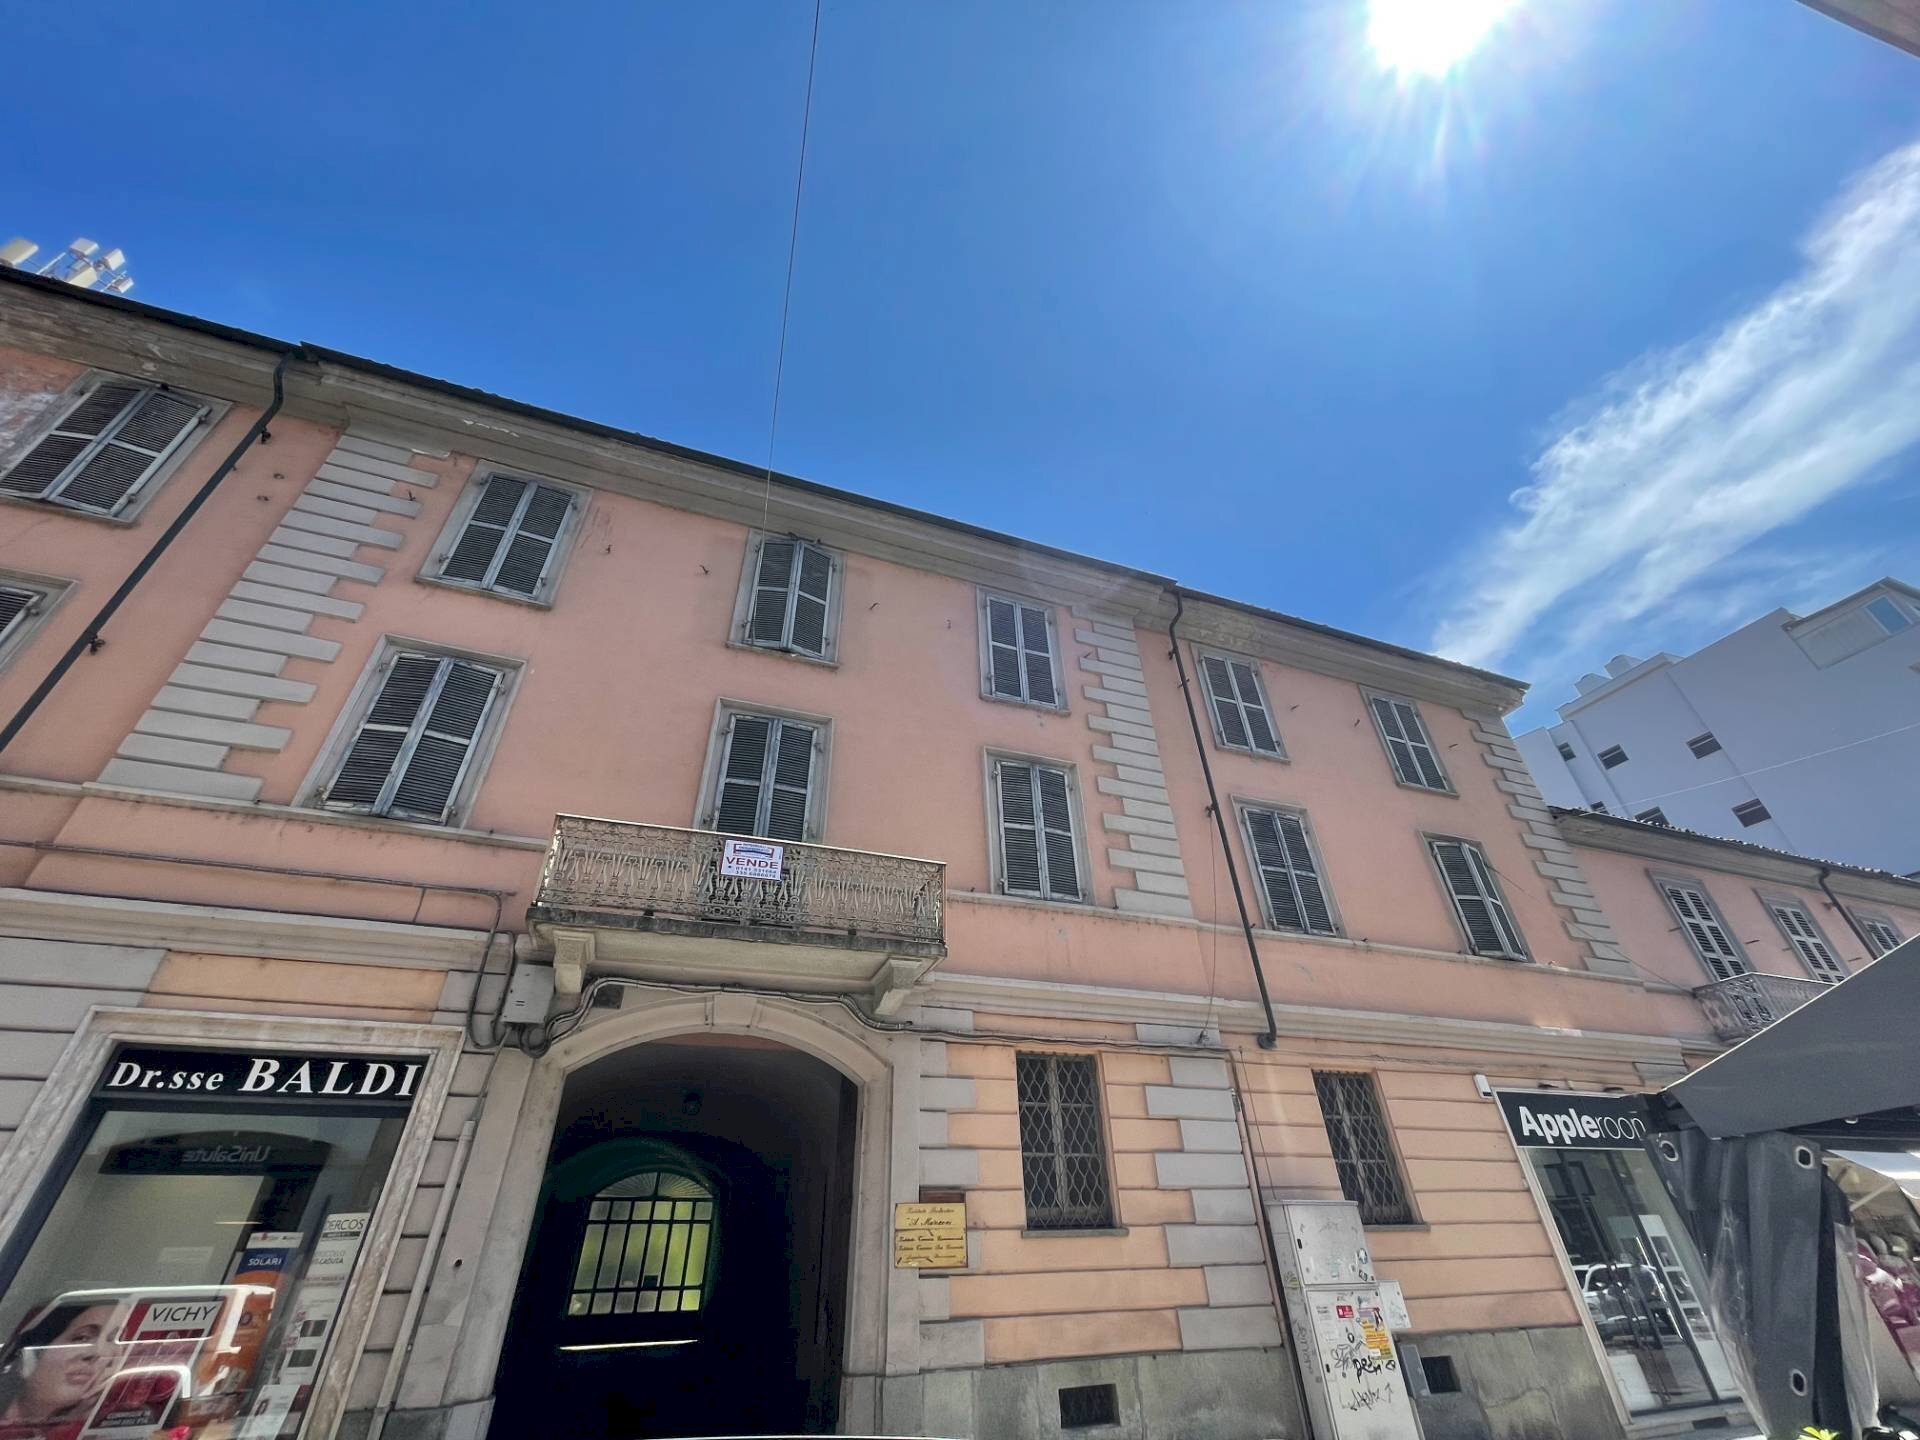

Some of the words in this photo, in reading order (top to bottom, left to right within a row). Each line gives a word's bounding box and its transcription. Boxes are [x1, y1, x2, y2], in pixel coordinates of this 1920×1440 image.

[726, 856, 779, 870] VENDE
[107, 1061, 226, 1091] Dr.sse
[237, 1058, 423, 1097] BALDI
[247, 1256, 283, 1267] SOLARI
[151, 1305, 218, 1323] VICHY
